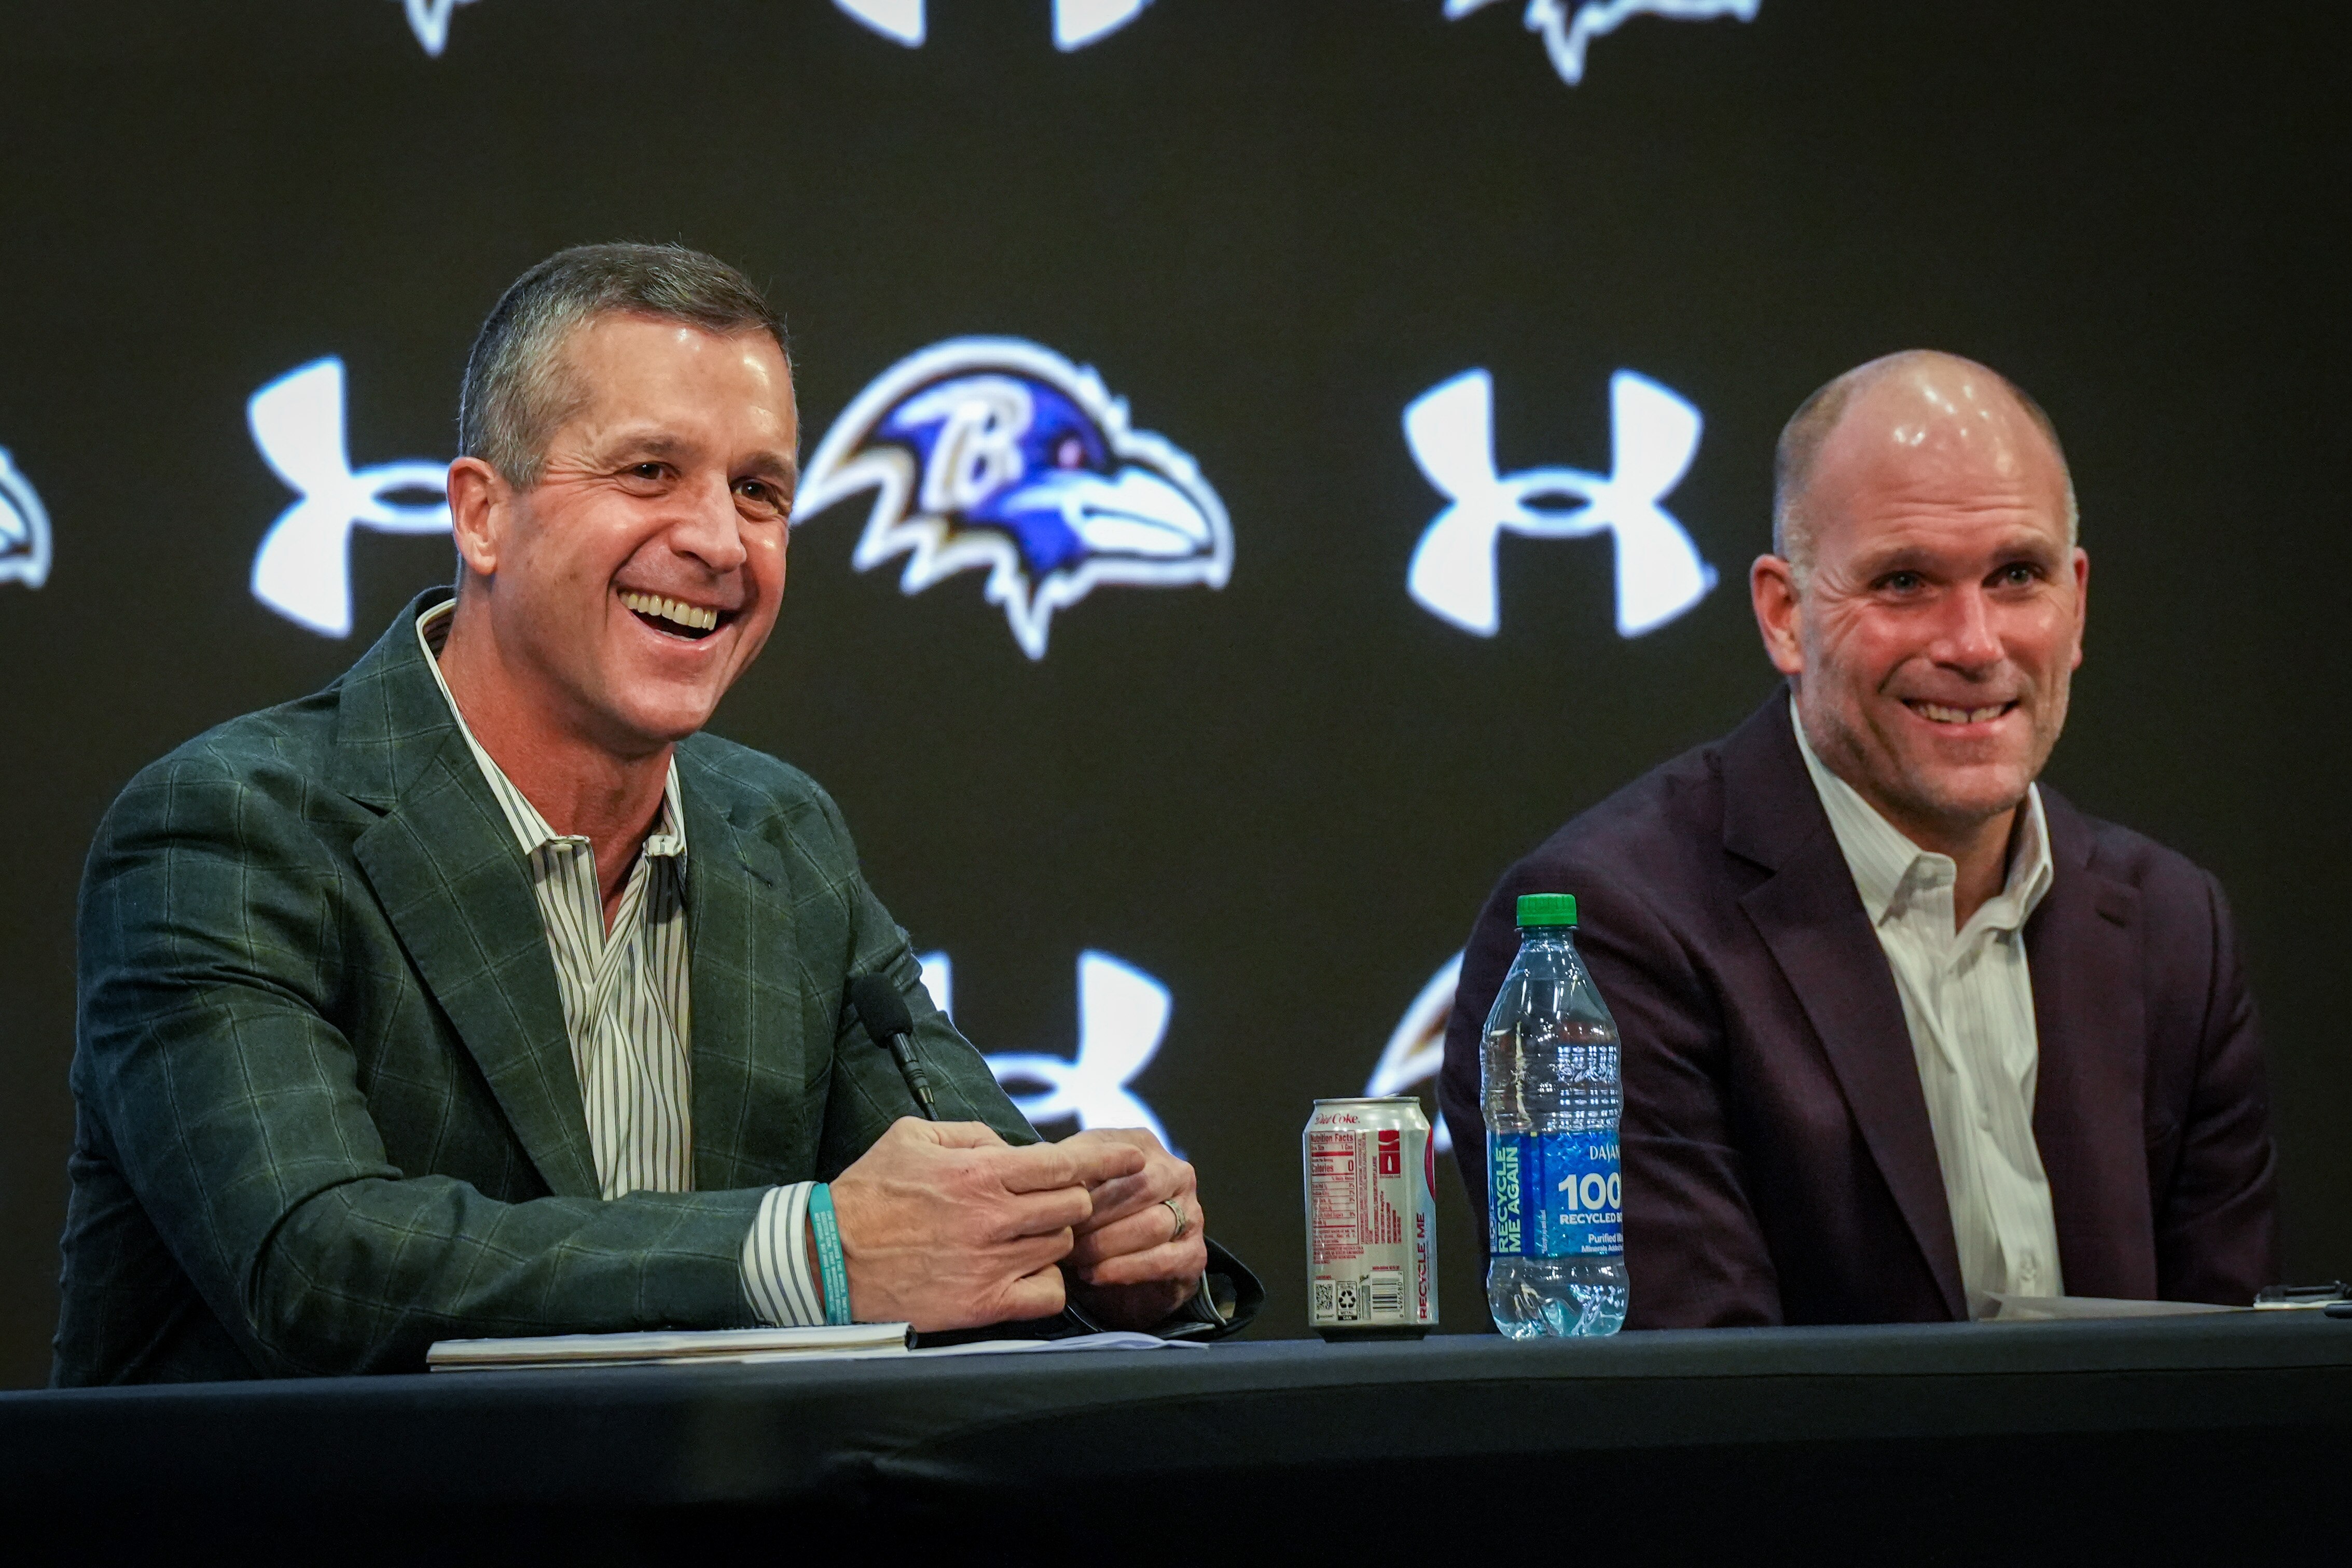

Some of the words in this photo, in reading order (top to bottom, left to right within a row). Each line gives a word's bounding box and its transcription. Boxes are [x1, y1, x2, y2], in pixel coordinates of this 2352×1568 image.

[1315, 1113, 1332, 1125] Diet
[1311, 1133, 1333, 1142] Nutrition
[1335, 1133, 1353, 1142] Facts
[1312, 1163, 1334, 1172] Calories
[1348, 1159, 1354, 1172] 0
[1506, 1147, 1520, 1215] AGAIN
[1496, 1147, 1509, 1253] RECYCLE
[1417, 1212, 1425, 1238] ME
[1560, 1213, 1616, 1225] RECYCLED
[1509, 1218, 1521, 1253] ME
[1588, 1232, 1616, 1244] Purified
[1418, 1242, 1428, 1320] RECYCLE
